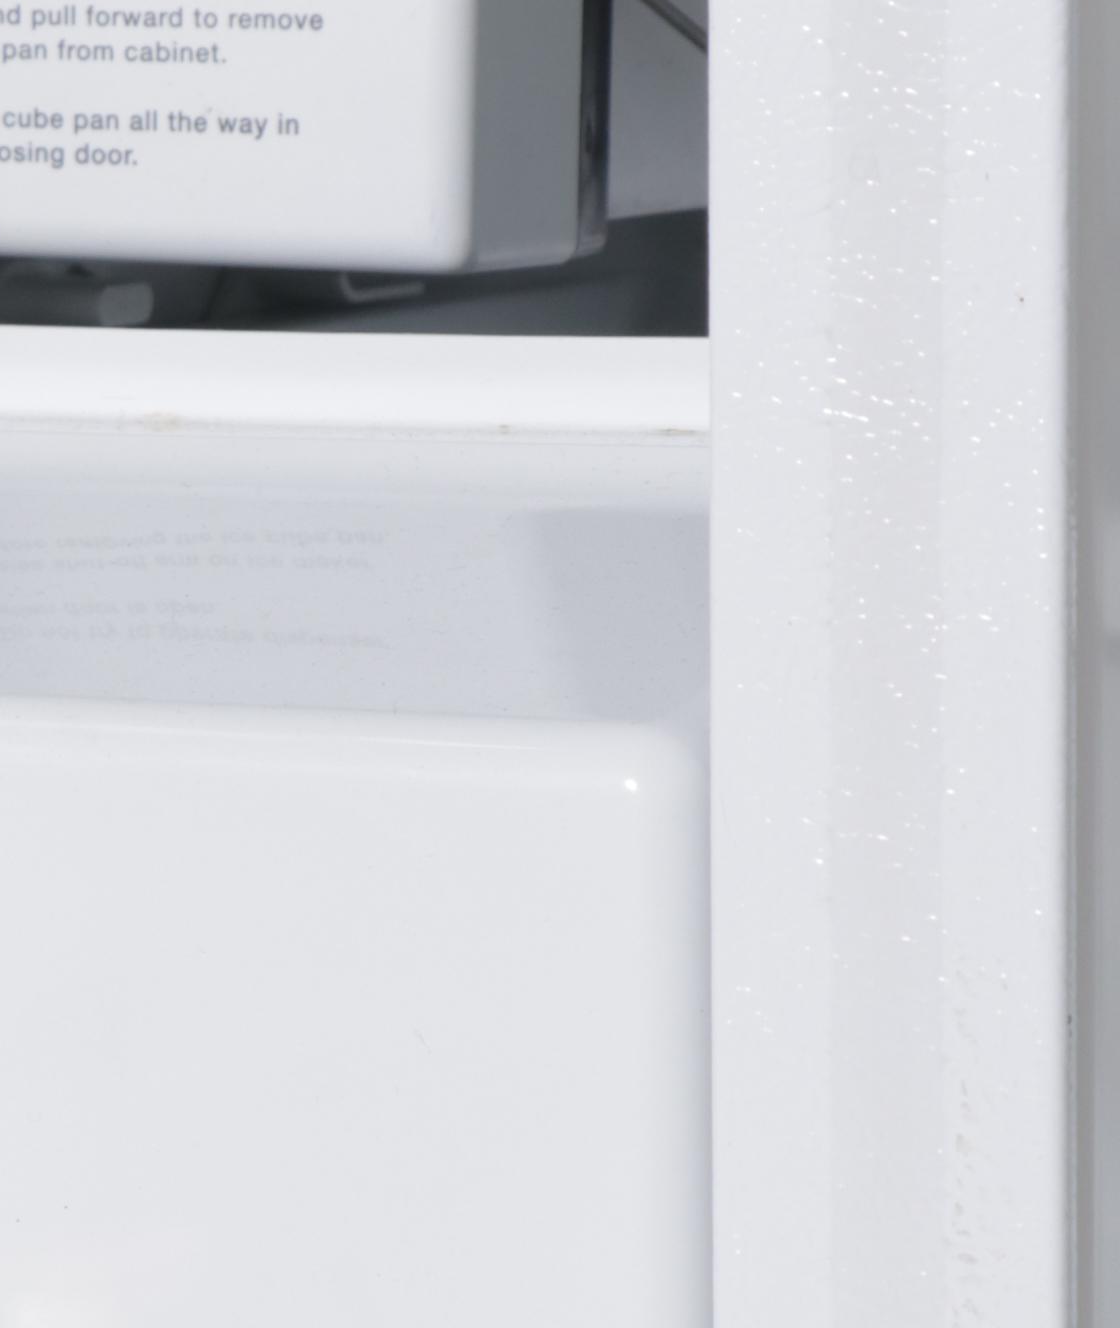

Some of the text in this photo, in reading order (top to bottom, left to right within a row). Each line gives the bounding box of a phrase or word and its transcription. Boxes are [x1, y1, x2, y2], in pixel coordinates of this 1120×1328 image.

[30, 4, 77, 31] pull
[85, 4, 184, 29] forward
[193, 8, 219, 30] to
[228, 12, 324, 32] remove
[1, 42, 48, 64] pan
[56, 38, 115, 62] from
[123, 41, 227, 64] cabinet.
[1, 107, 65, 130] cube
[73, 112, 120, 135] pan
[128, 109, 158, 133] all
[167, 111, 208, 134] the
[216, 116, 269, 141] way
[277, 112, 300, 136] in
[73, 143, 138, 166] door.
